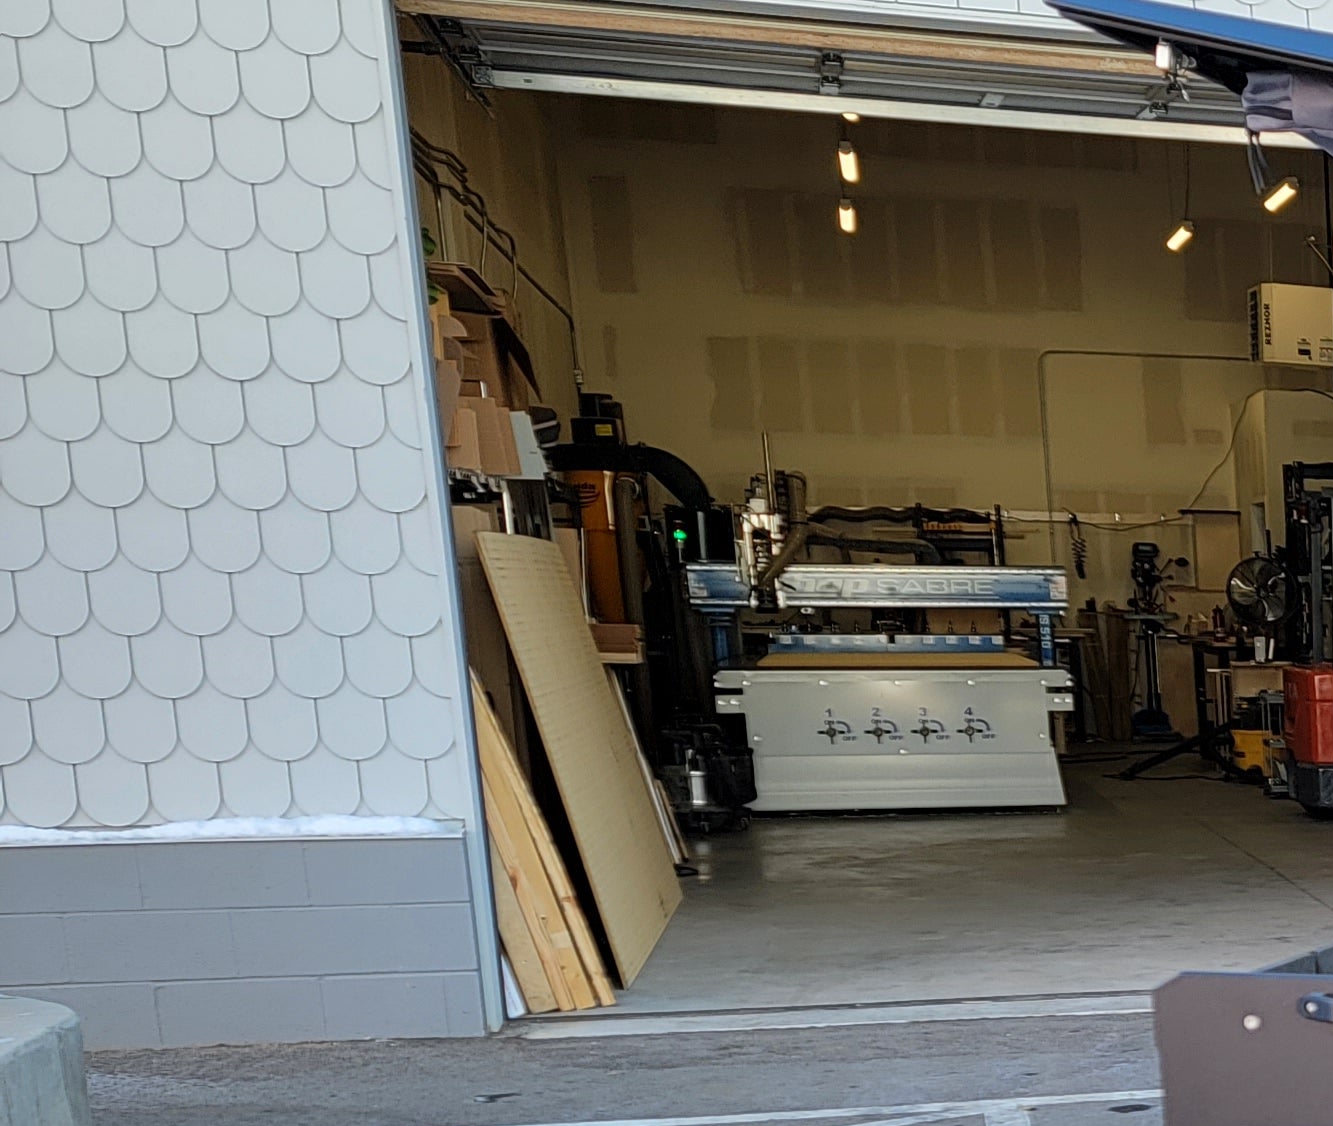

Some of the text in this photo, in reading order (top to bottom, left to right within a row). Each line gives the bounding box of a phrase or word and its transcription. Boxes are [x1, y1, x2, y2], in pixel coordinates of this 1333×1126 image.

[876, 578, 994, 595] SABRE
[825, 708, 833, 717] 1
[871, 707, 881, 717] 2
[918, 707, 928, 717] 3
[963, 706, 974, 716] 4
